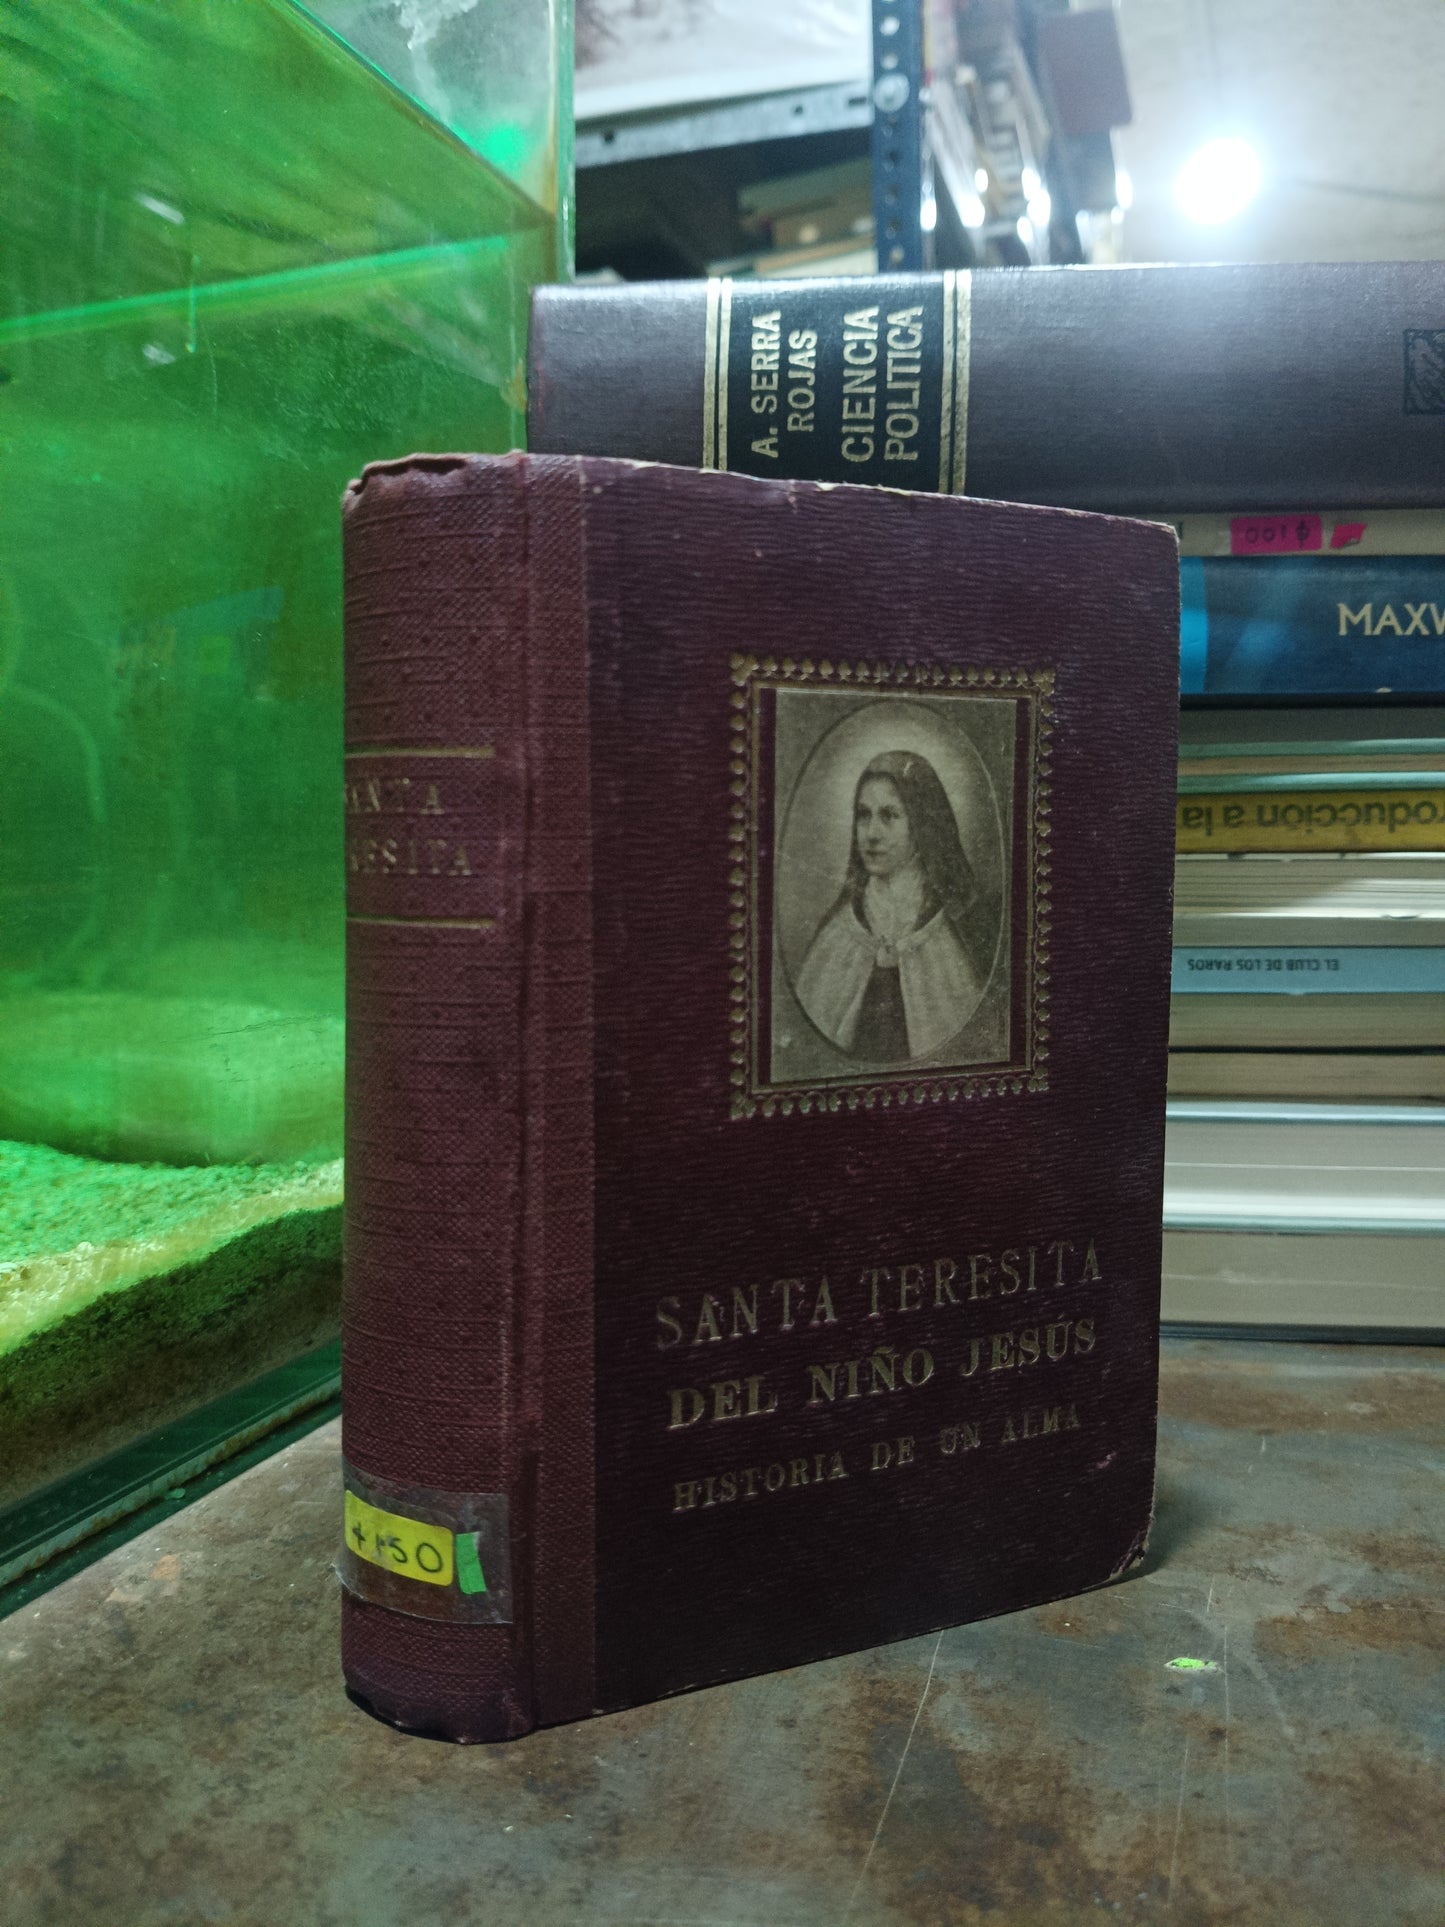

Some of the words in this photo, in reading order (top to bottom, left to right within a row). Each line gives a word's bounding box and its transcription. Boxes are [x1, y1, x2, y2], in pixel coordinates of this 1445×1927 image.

[751, 310, 782, 414] SERRA
[787, 329, 818, 432] ROJAS
[841, 305, 880, 463] CIENCIA
[884, 304, 924, 461] POLITICA
[751, 427, 779, 458] A.
[1182, 804, 1213, 837] la
[1222, 803, 1245, 828] a
[1256, 801, 1445, 835] oducción
[1187, 958, 1232, 971] RAROS
[1237, 958, 1260, 971] LOS
[1265, 958, 1282, 971] DE
[1286, 958, 1321, 971] CLUB
[1326, 958, 1340, 971] EL
[656, 1274, 839, 1350] SANTA
[860, 1238, 1103, 1319] TERESITA
[666, 1374, 779, 1431] DEL
[807, 1345, 935, 1407] NIÑO
[961, 1312, 1097, 1377] JESÚS
[671, 1450, 850, 1513] HISTORIA
[870, 1435, 917, 1471] DE
[940, 1422, 982, 1455] UN
[1001, 1403, 1082, 1444] ALMA
